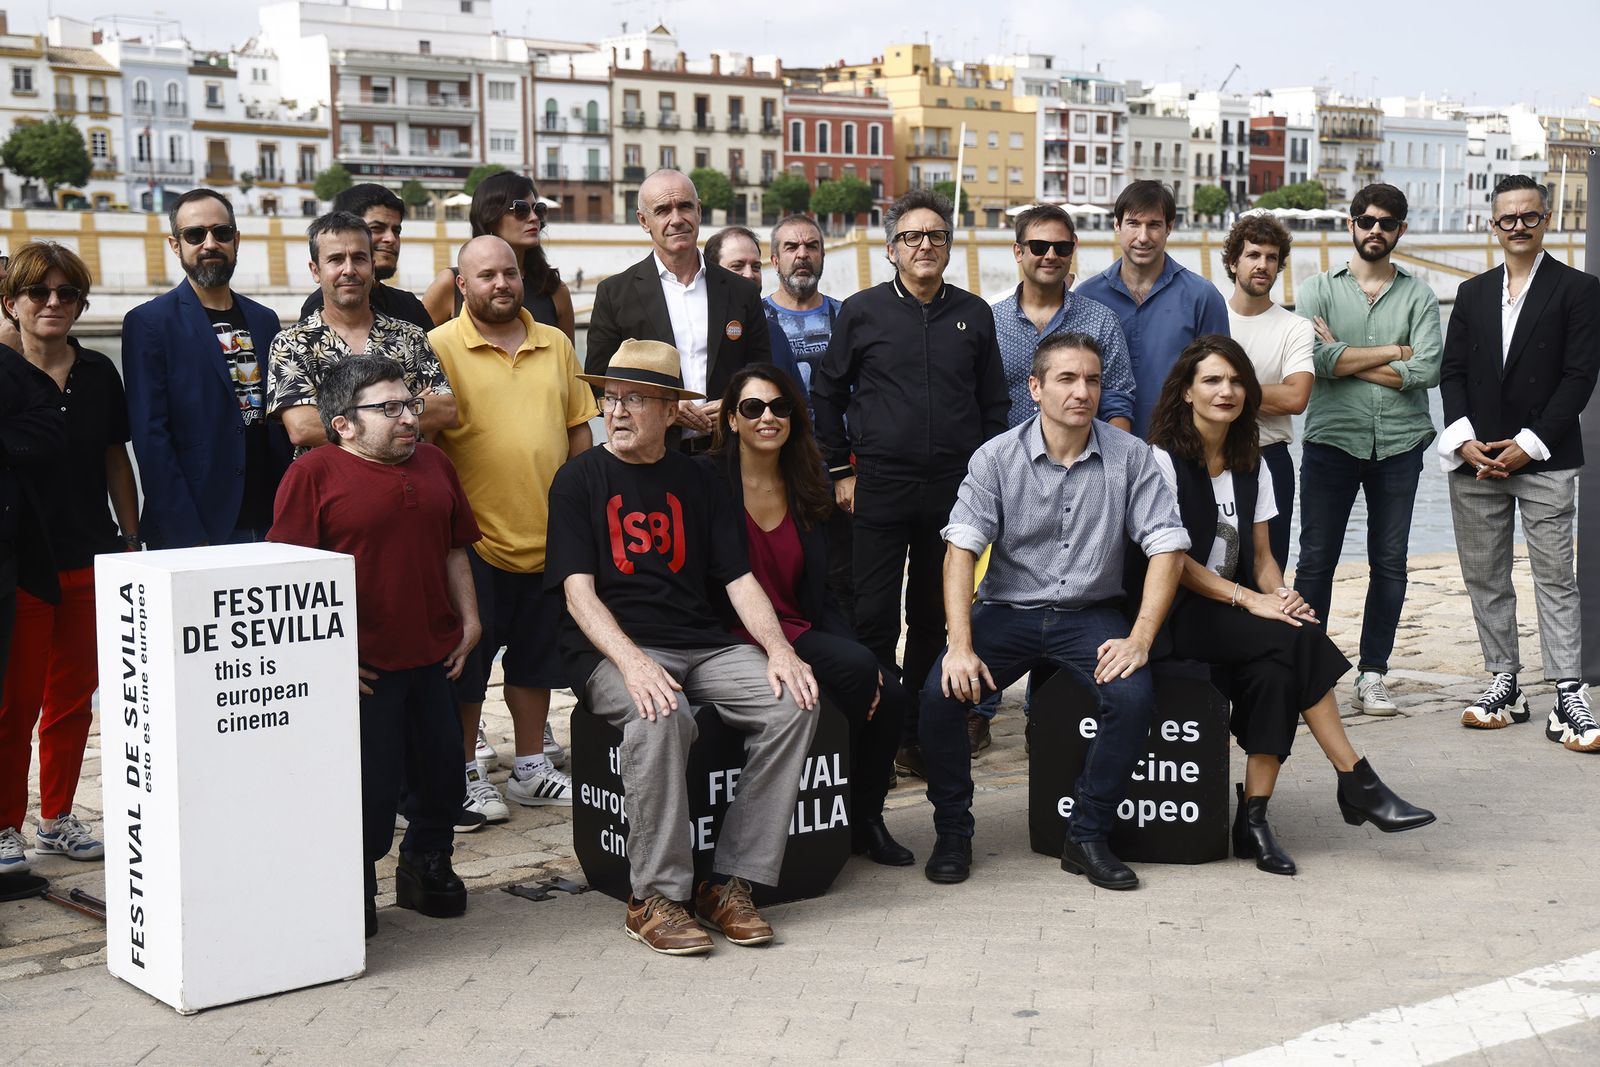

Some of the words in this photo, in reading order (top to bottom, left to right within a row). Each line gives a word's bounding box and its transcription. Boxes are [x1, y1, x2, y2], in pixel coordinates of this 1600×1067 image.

[213, 580, 344, 619] FESTIVAL
[138, 583, 149, 665] europeo
[182, 623, 220, 654] DE
[230, 611, 345, 649] SEVILLA
[119, 582, 139, 729] SEVILLA
[214, 658, 252, 681] this
[260, 655, 277, 676] is
[140, 671, 150, 715] cine
[216, 680, 309, 707] european
[143, 721, 151, 745] es
[217, 710, 290, 734] cinema
[1160, 719, 1200, 743] es
[125, 741, 141, 788] DE
[144, 751, 153, 793] esto
[708, 752, 848, 805] FEVAL
[580, 782, 628, 824] europ
[1057, 796, 1200, 828] eopeo
[600, 824, 626, 859] cin
[127, 803, 145, 969] FESTIVAL
